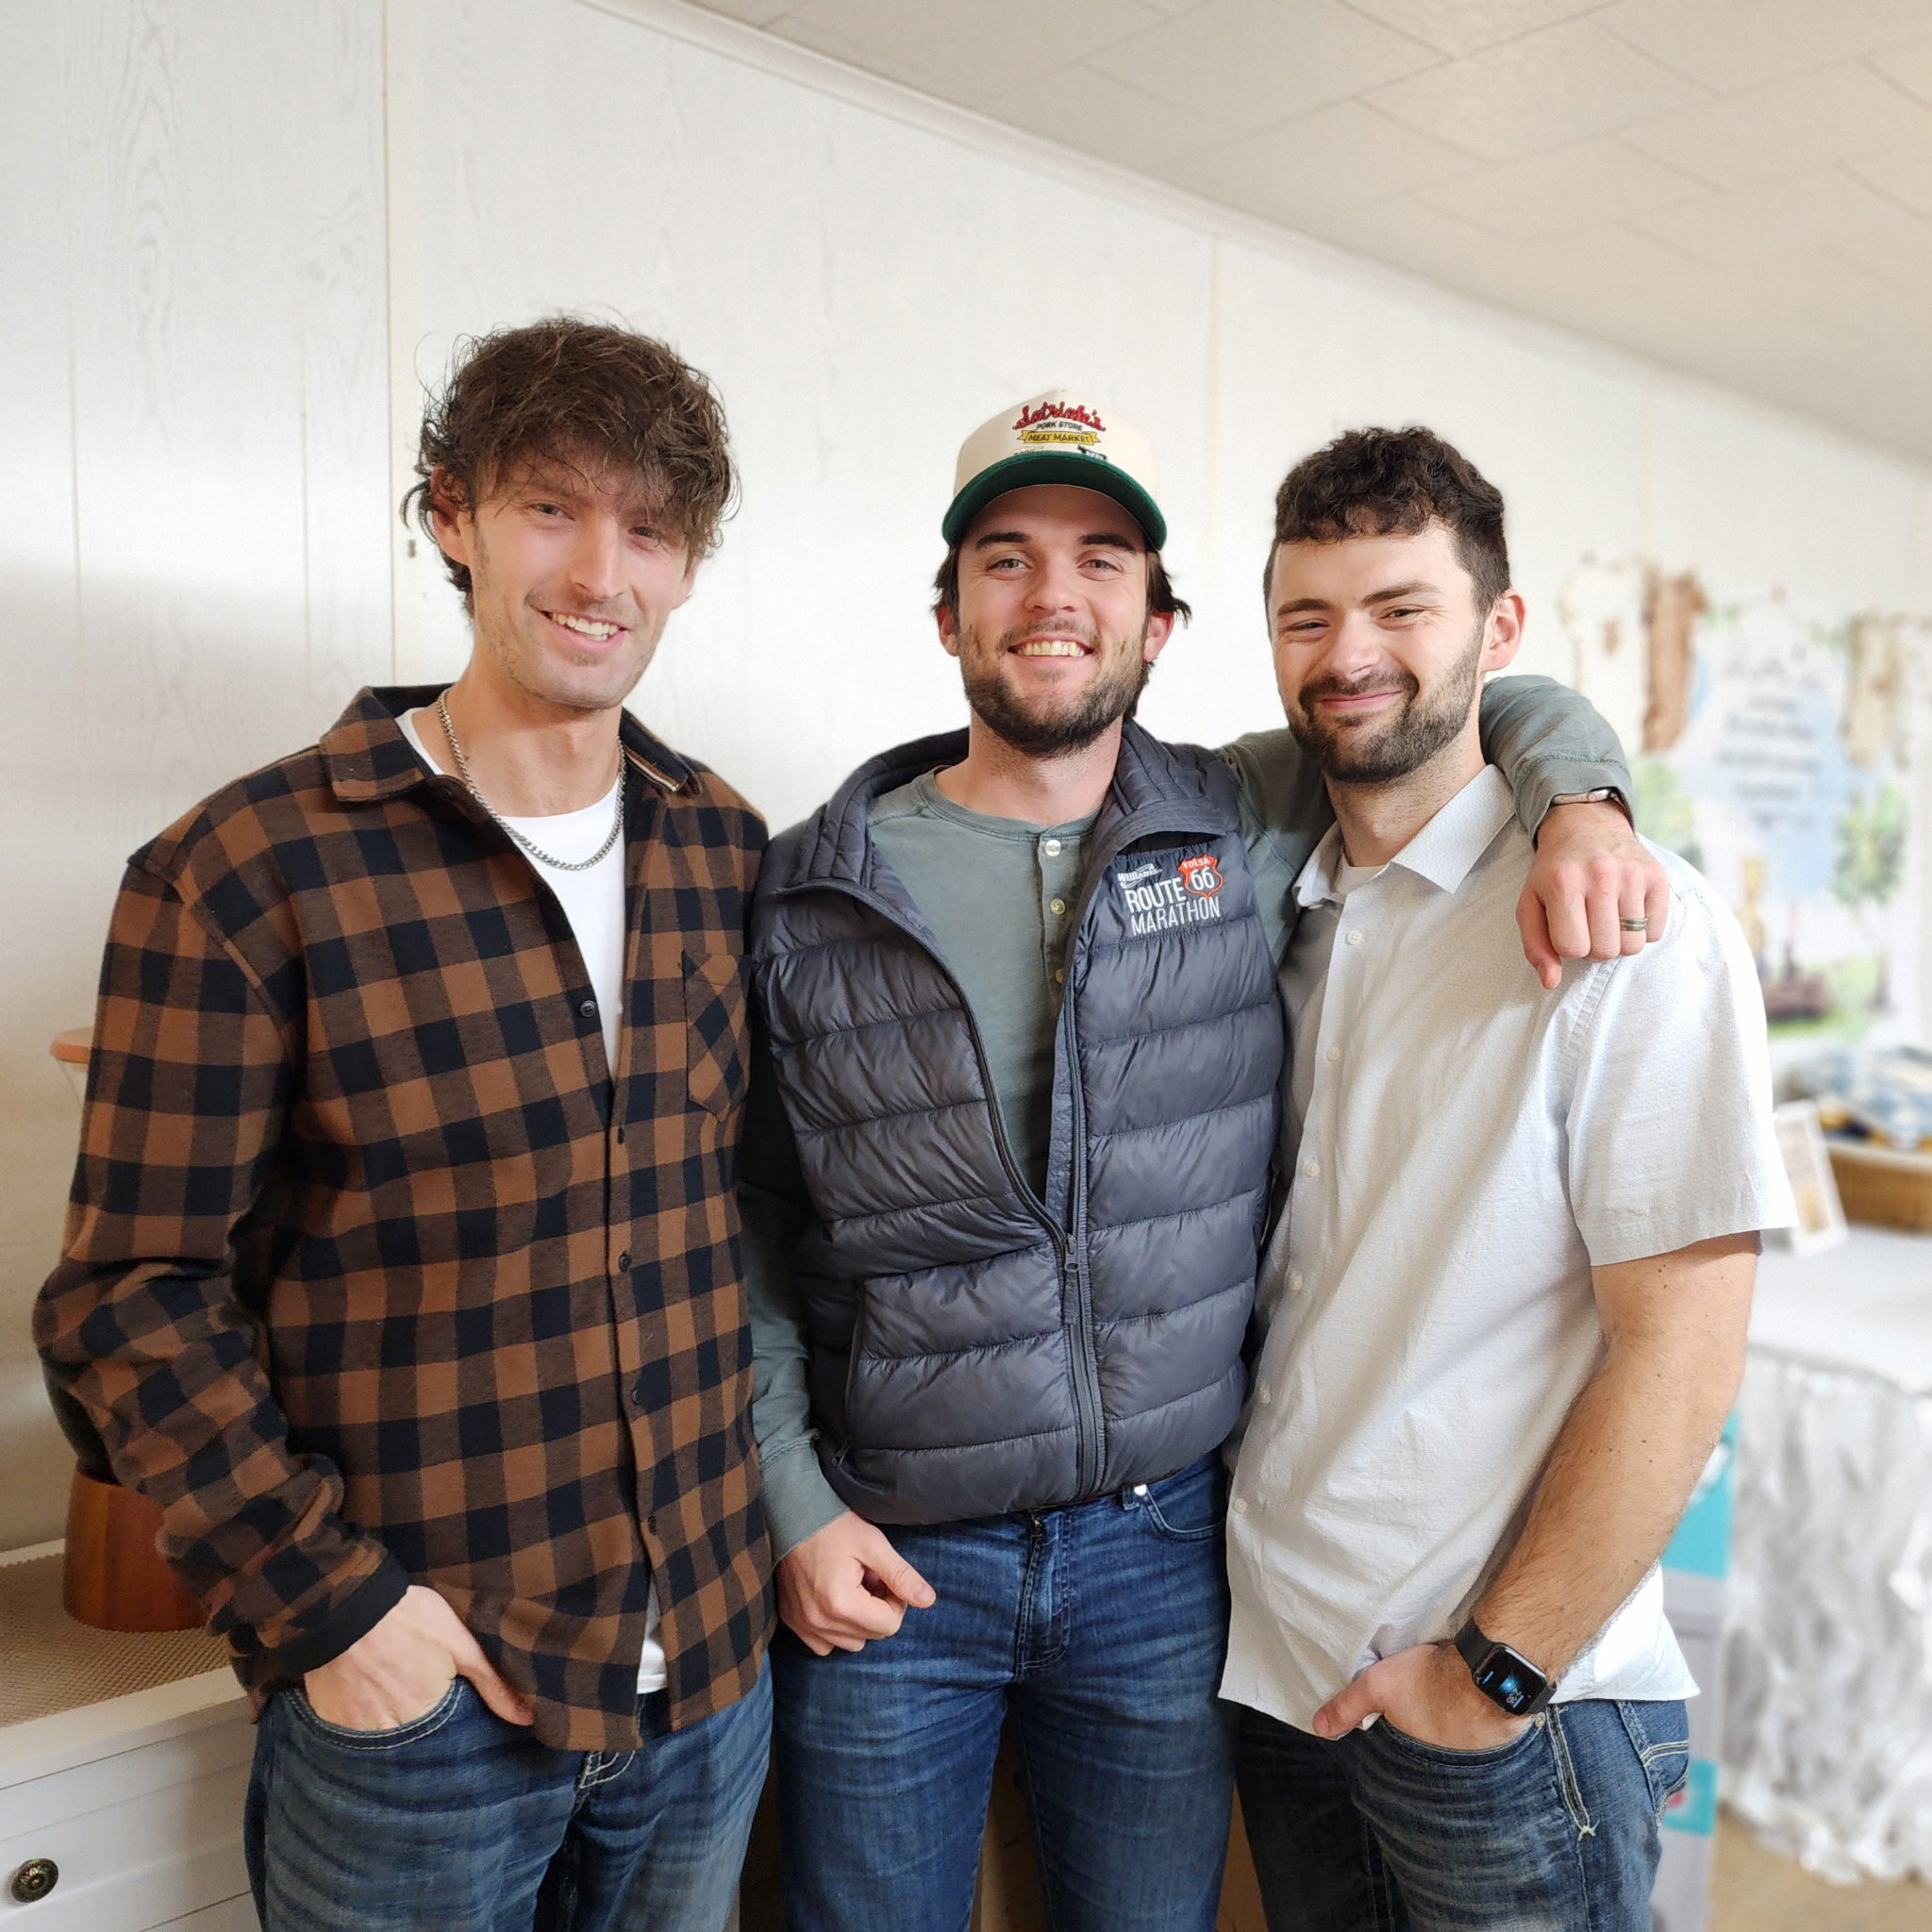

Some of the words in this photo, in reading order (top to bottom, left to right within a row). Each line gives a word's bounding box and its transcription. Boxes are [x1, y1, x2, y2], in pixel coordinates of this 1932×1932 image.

[1036, 420, 1057, 430] PORK
[1058, 421, 1084, 431] STORE
[1027, 433, 1052, 441] MEAT
[1053, 433, 1091, 442] MARKET
[1183, 858, 1210, 868] TULSA
[1124, 877, 1187, 913] ROUTE
[1191, 867, 1215, 891] 66
[1131, 896, 1221, 936] MARATHON
